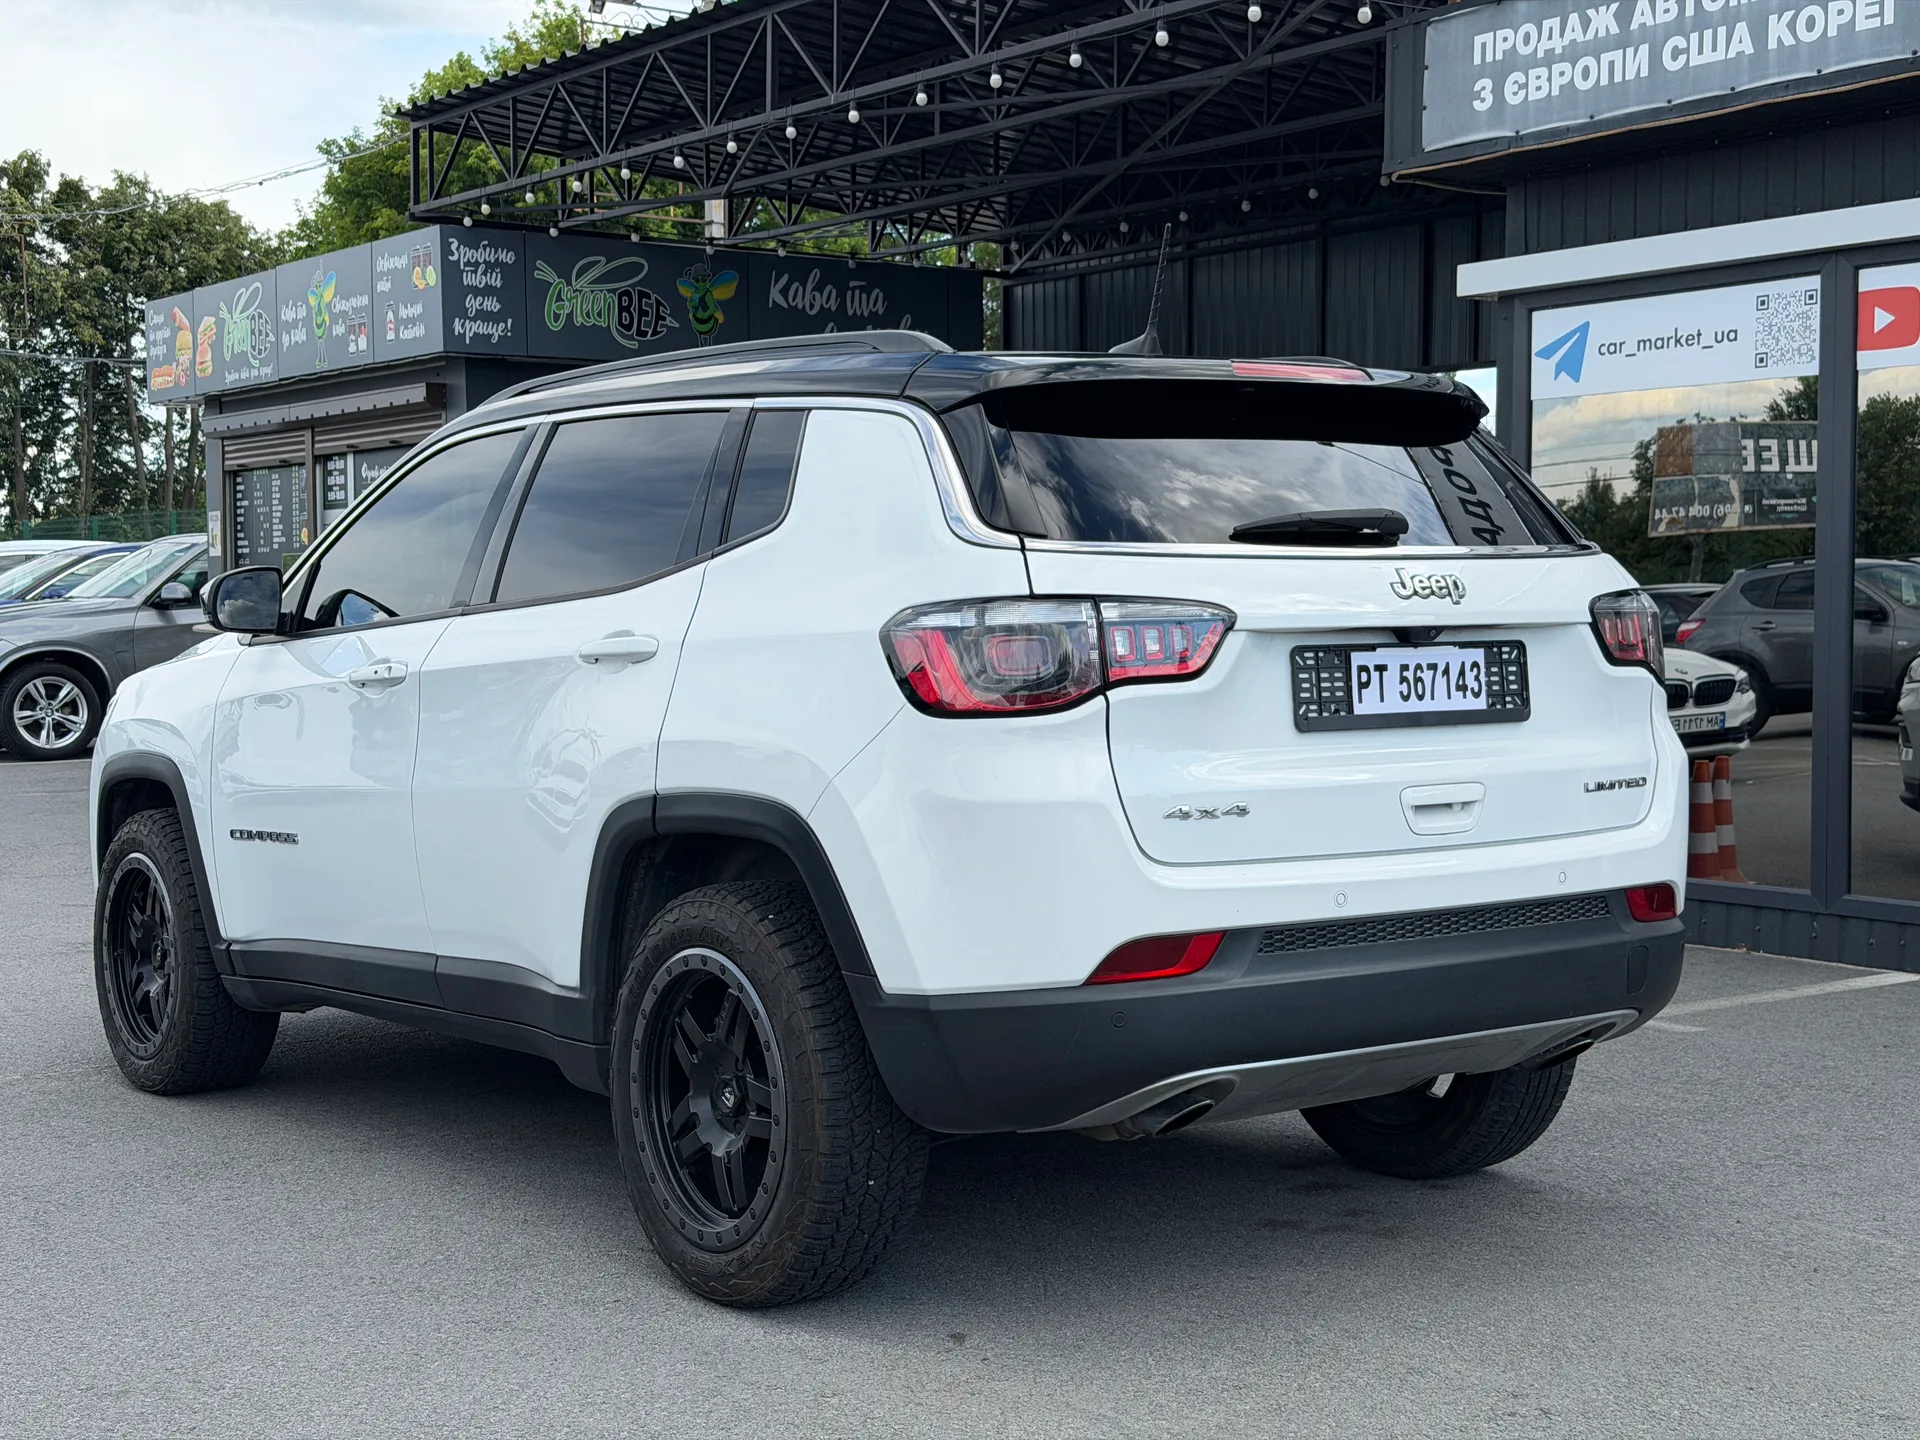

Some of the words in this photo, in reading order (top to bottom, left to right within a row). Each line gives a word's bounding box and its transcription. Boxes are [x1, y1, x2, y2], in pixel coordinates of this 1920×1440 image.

[1473, 2, 1619, 65] ПРОДАЖ
[1472, 78, 1494, 112] З
[1503, 45, 1649, 107] ЄВРОПИ
[1662, 21, 1755, 72] США
[448, 238, 516, 270] Зробимо
[462, 264, 503, 289] твій
[465, 293, 502, 317] день
[768, 268, 841, 316] Кава
[846, 280, 888, 317] та
[452, 317, 513, 345] краще!
[1598, 327, 1739, 358] car_market_ua
[1389, 567, 1467, 605] Jeep
[1356, 663, 1389, 704] PT
[1398, 660, 1483, 703] 567143
[1583, 776, 1648, 794] LIMITED
[229, 828, 299, 845] COMPASS
